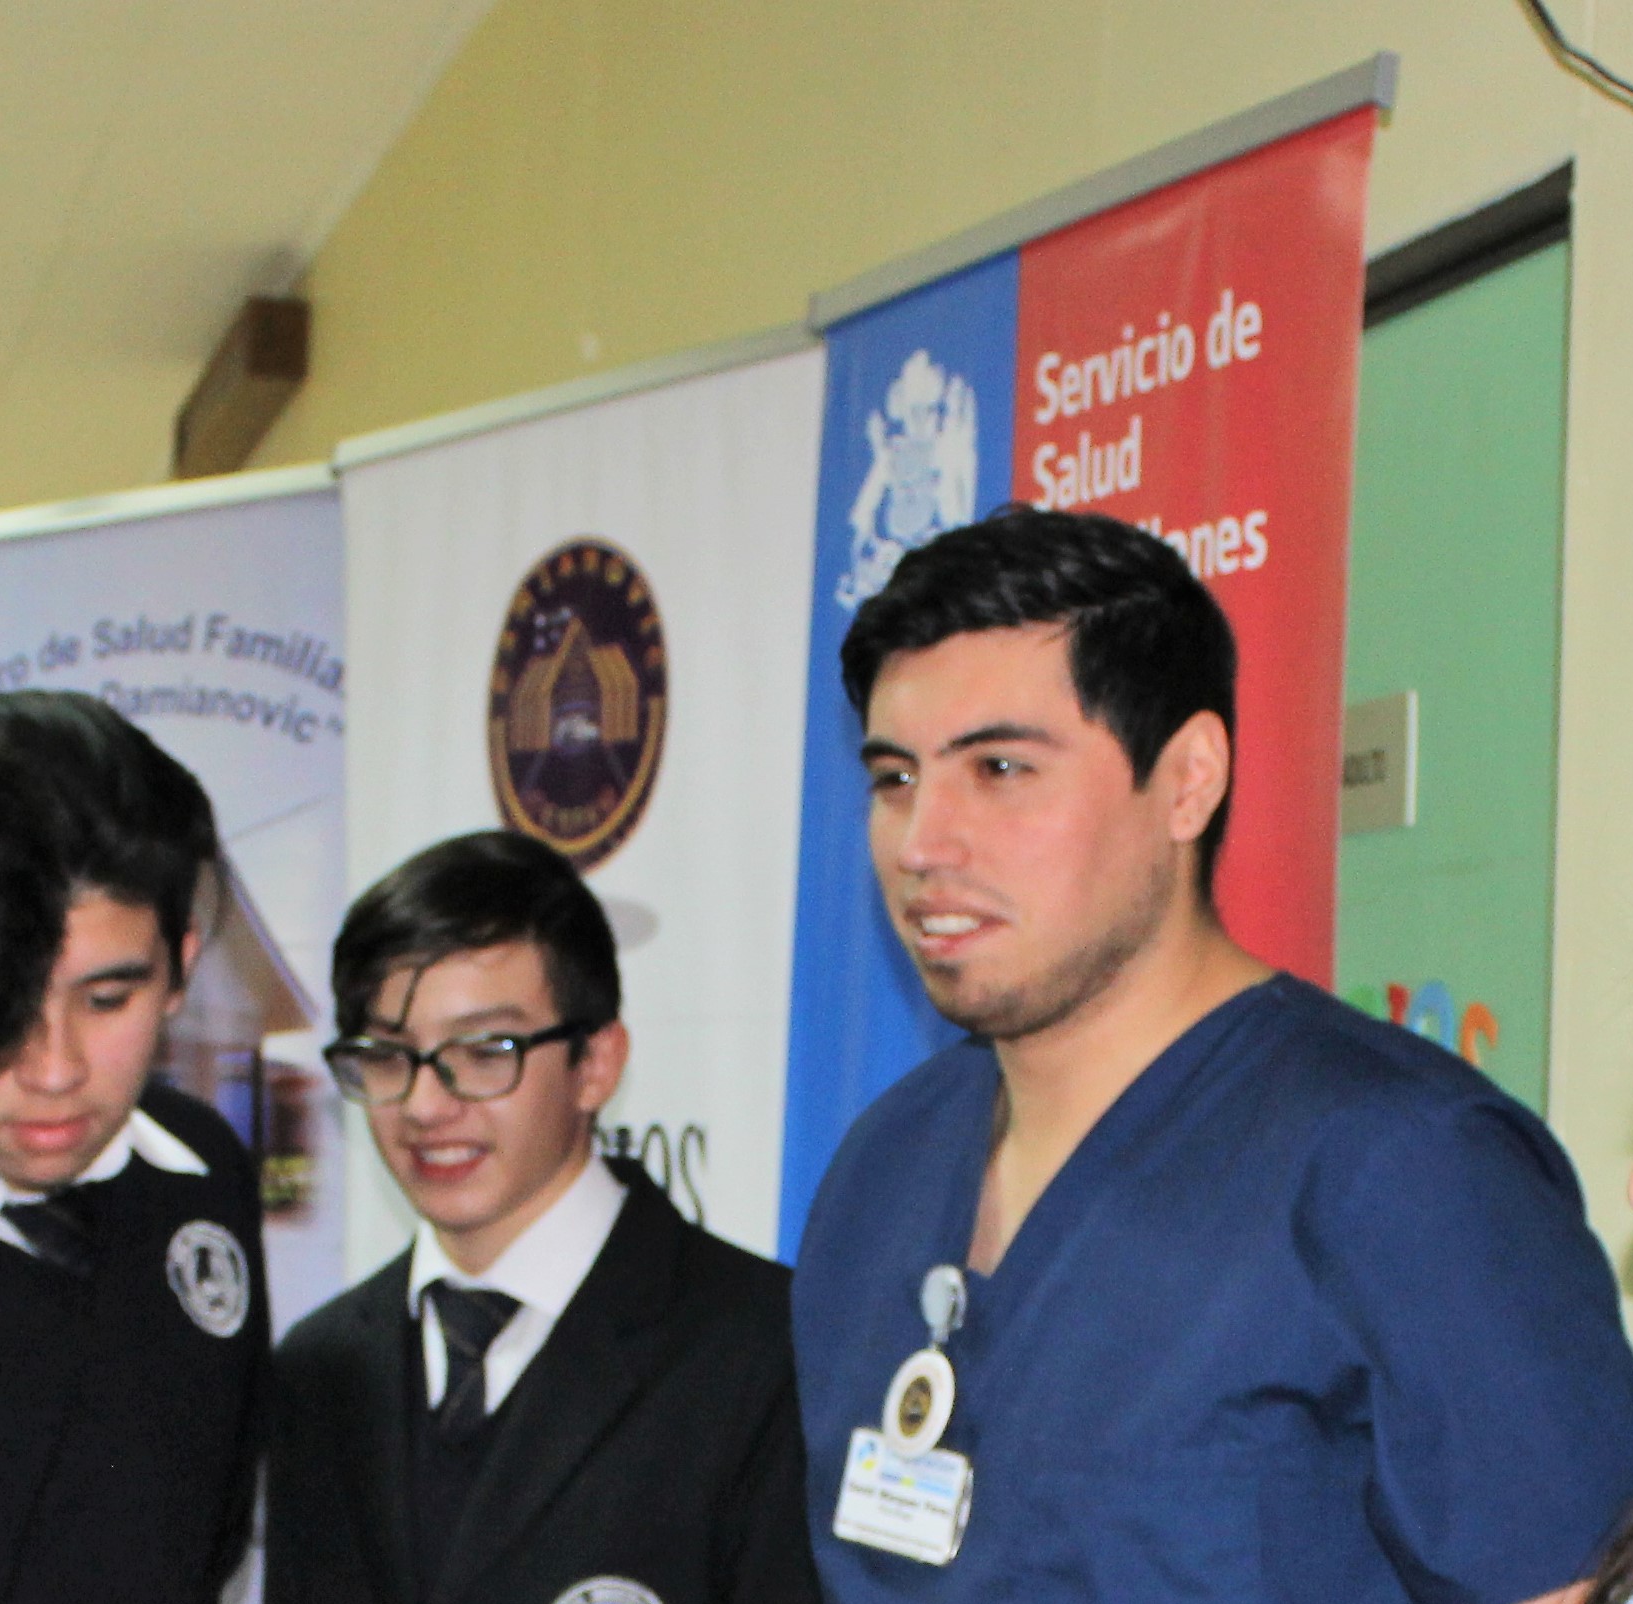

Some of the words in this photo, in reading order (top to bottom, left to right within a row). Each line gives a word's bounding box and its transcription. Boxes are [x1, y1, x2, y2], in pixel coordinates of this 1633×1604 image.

[1033, 310, 1196, 425] Servicio
[1205, 287, 1264, 370] de
[1032, 412, 1143, 513] Salud
[36, 632, 81, 673] de
[92, 612, 195, 659] Salud
[202, 612, 346, 699] Familia
